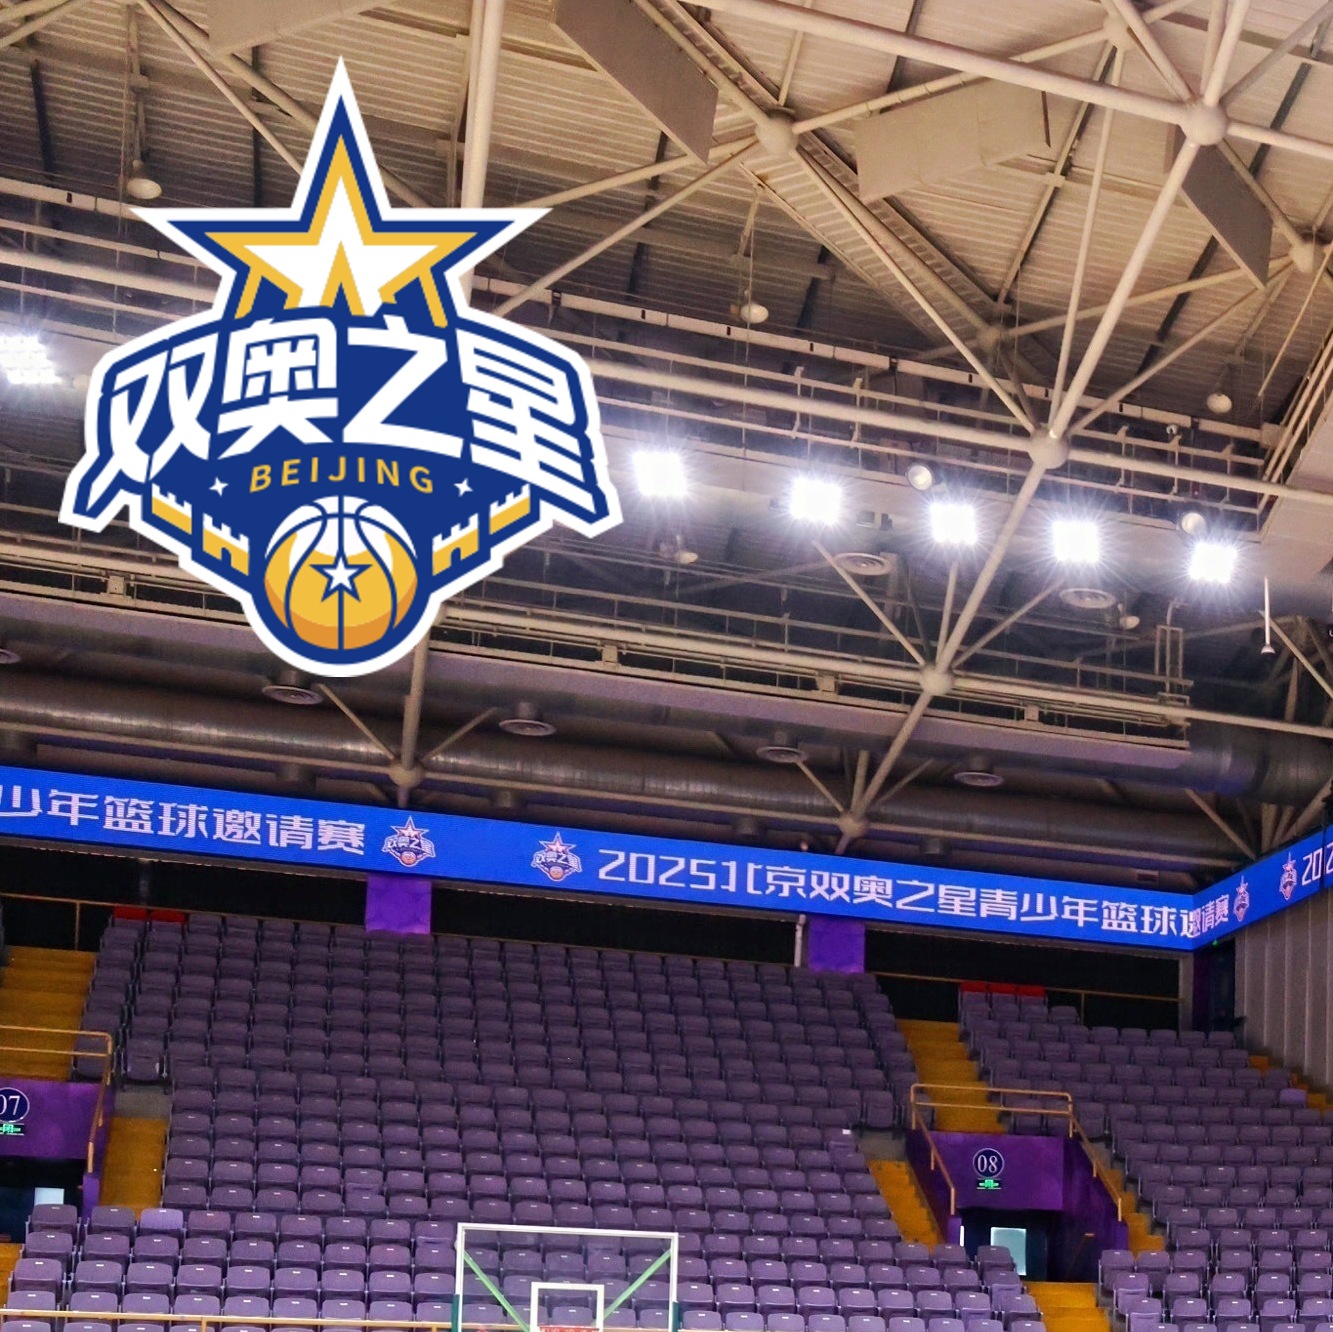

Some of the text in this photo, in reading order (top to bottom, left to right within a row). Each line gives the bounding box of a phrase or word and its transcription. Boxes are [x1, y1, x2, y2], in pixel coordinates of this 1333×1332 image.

[598, 848, 1229, 938] 2025北京双奥之星青少年篮球邀请赛
[977, 1154, 998, 1173] 08
